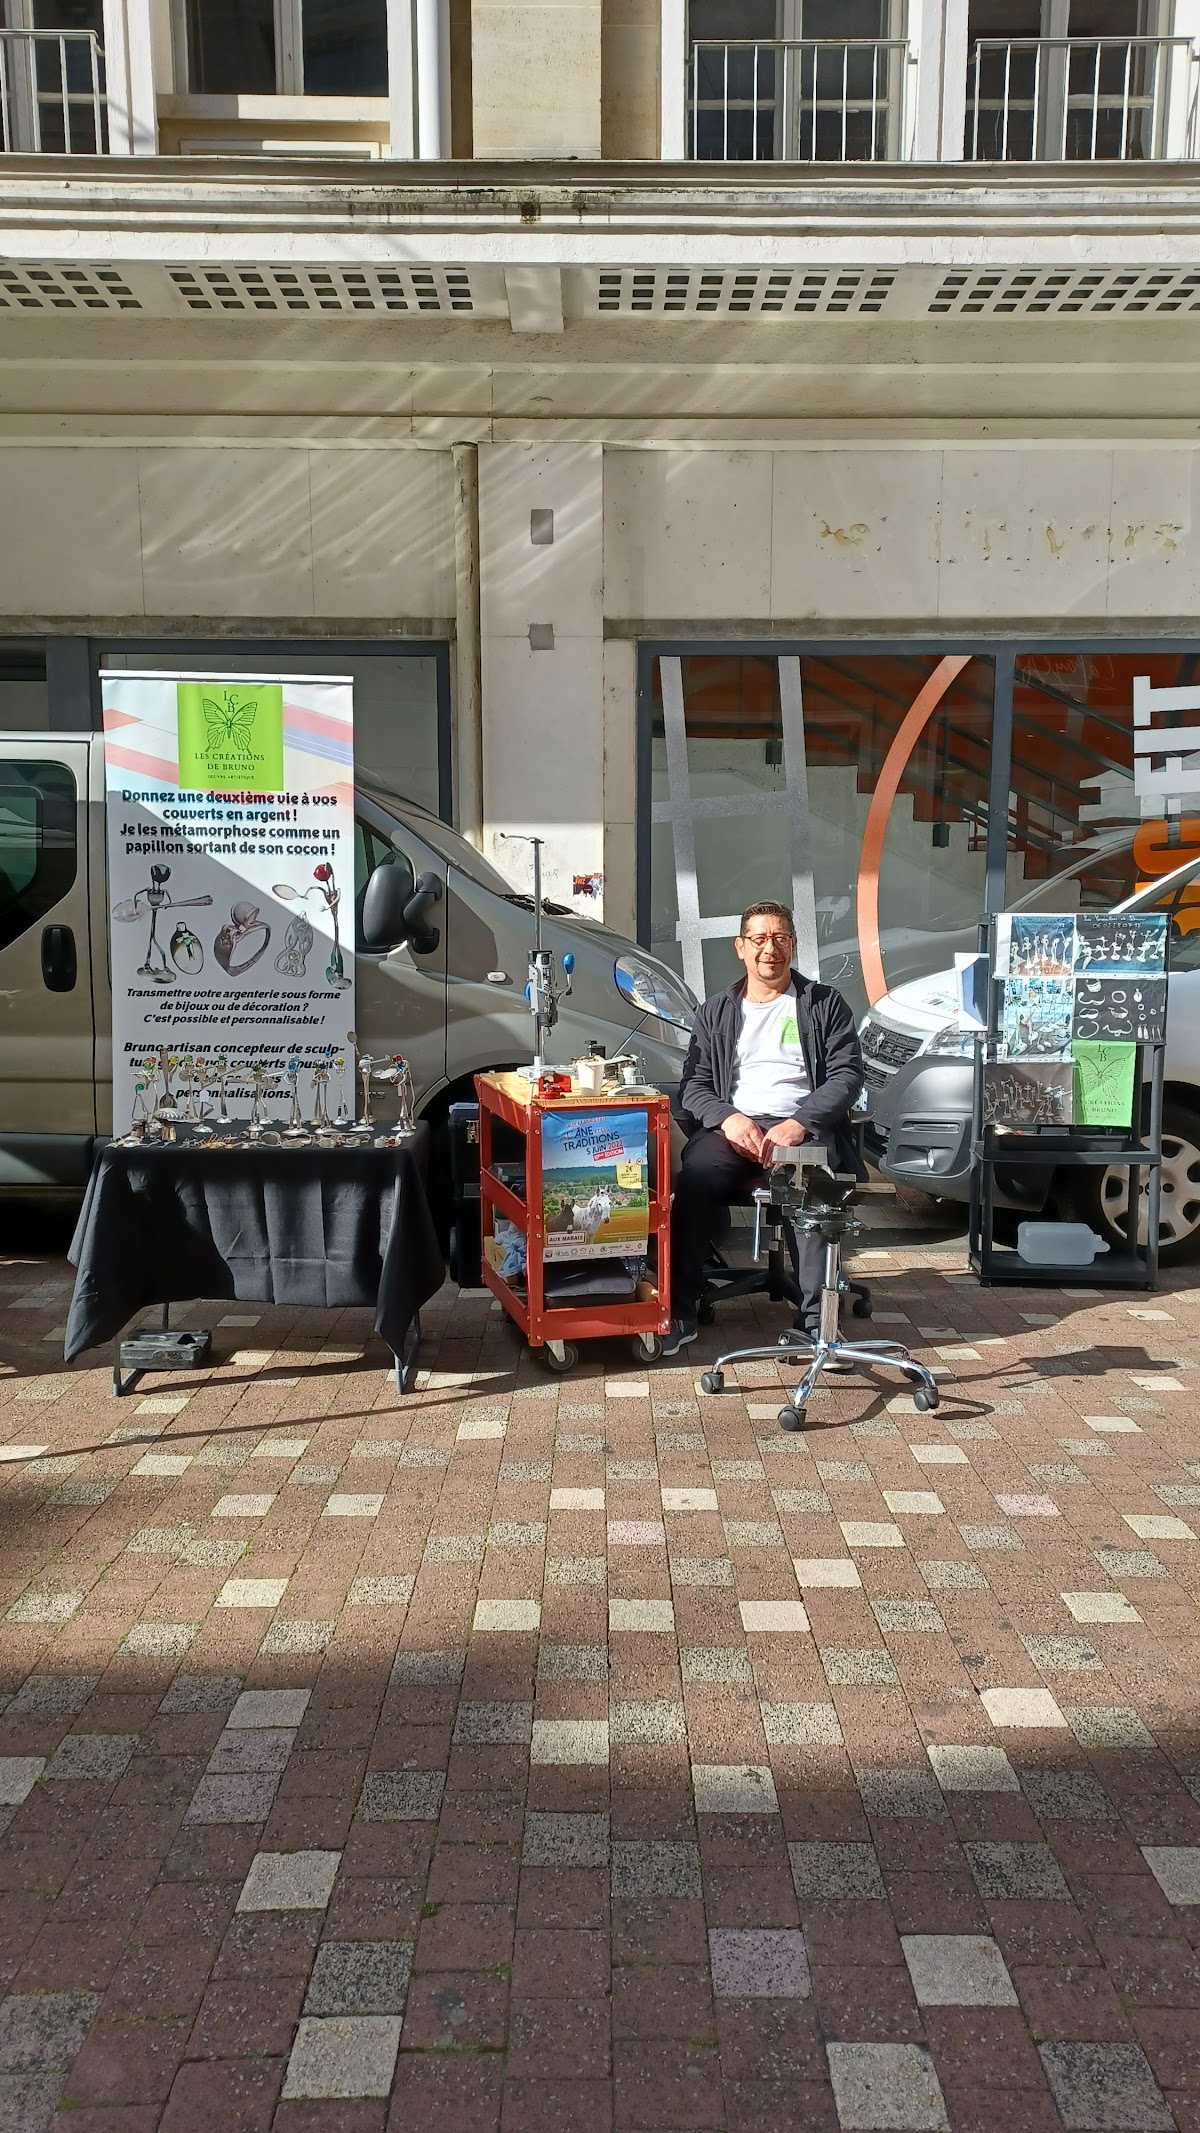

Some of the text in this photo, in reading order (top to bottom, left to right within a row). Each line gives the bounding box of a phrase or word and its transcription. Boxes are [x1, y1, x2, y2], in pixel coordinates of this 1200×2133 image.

[194, 751, 265, 762] LES CRÉATIONS
[222, 763, 255, 771] BRUNO
[122, 789, 337, 806] Donnez une deuxième vie à vos
[162, 808, 224, 821] couverts
[226, 810, 243, 821] en
[246, 810, 291, 824] argent
[120, 824, 341, 841] Je les métamorphose comme un
[125, 840, 184, 855] papillon
[186, 842, 236, 855] sortant
[239, 842, 256, 855] de
[258, 844, 284, 855] son
[287, 845, 328, 856] cocon
[127, 988, 341, 1000] Transmettre votre argenterie sous forme
[160, 1001, 174, 1011] de
[175, 1001, 210, 1013] bijoux
[211, 1003, 225, 1011] ou
[227, 1001, 241, 1011] de
[242, 1001, 300, 1012] décoration
[143, 1013, 171, 1024] C'est
[172, 1013, 219, 1025] possible
[220, 1015, 230, 1024] et
[231, 1014, 318, 1027] personnalisable
[165, 1042, 211, 1053] artisan
[213, 1043, 285, 1056] concepteur
[287, 1043, 303, 1054] de
[230, 1058, 286, 1069] courts
[176, 1087, 294, 1100] persnnalisaions.
[563, 1131, 620, 1151] TRADITIONS
[593, 1143, 607, 1154] JUIN
